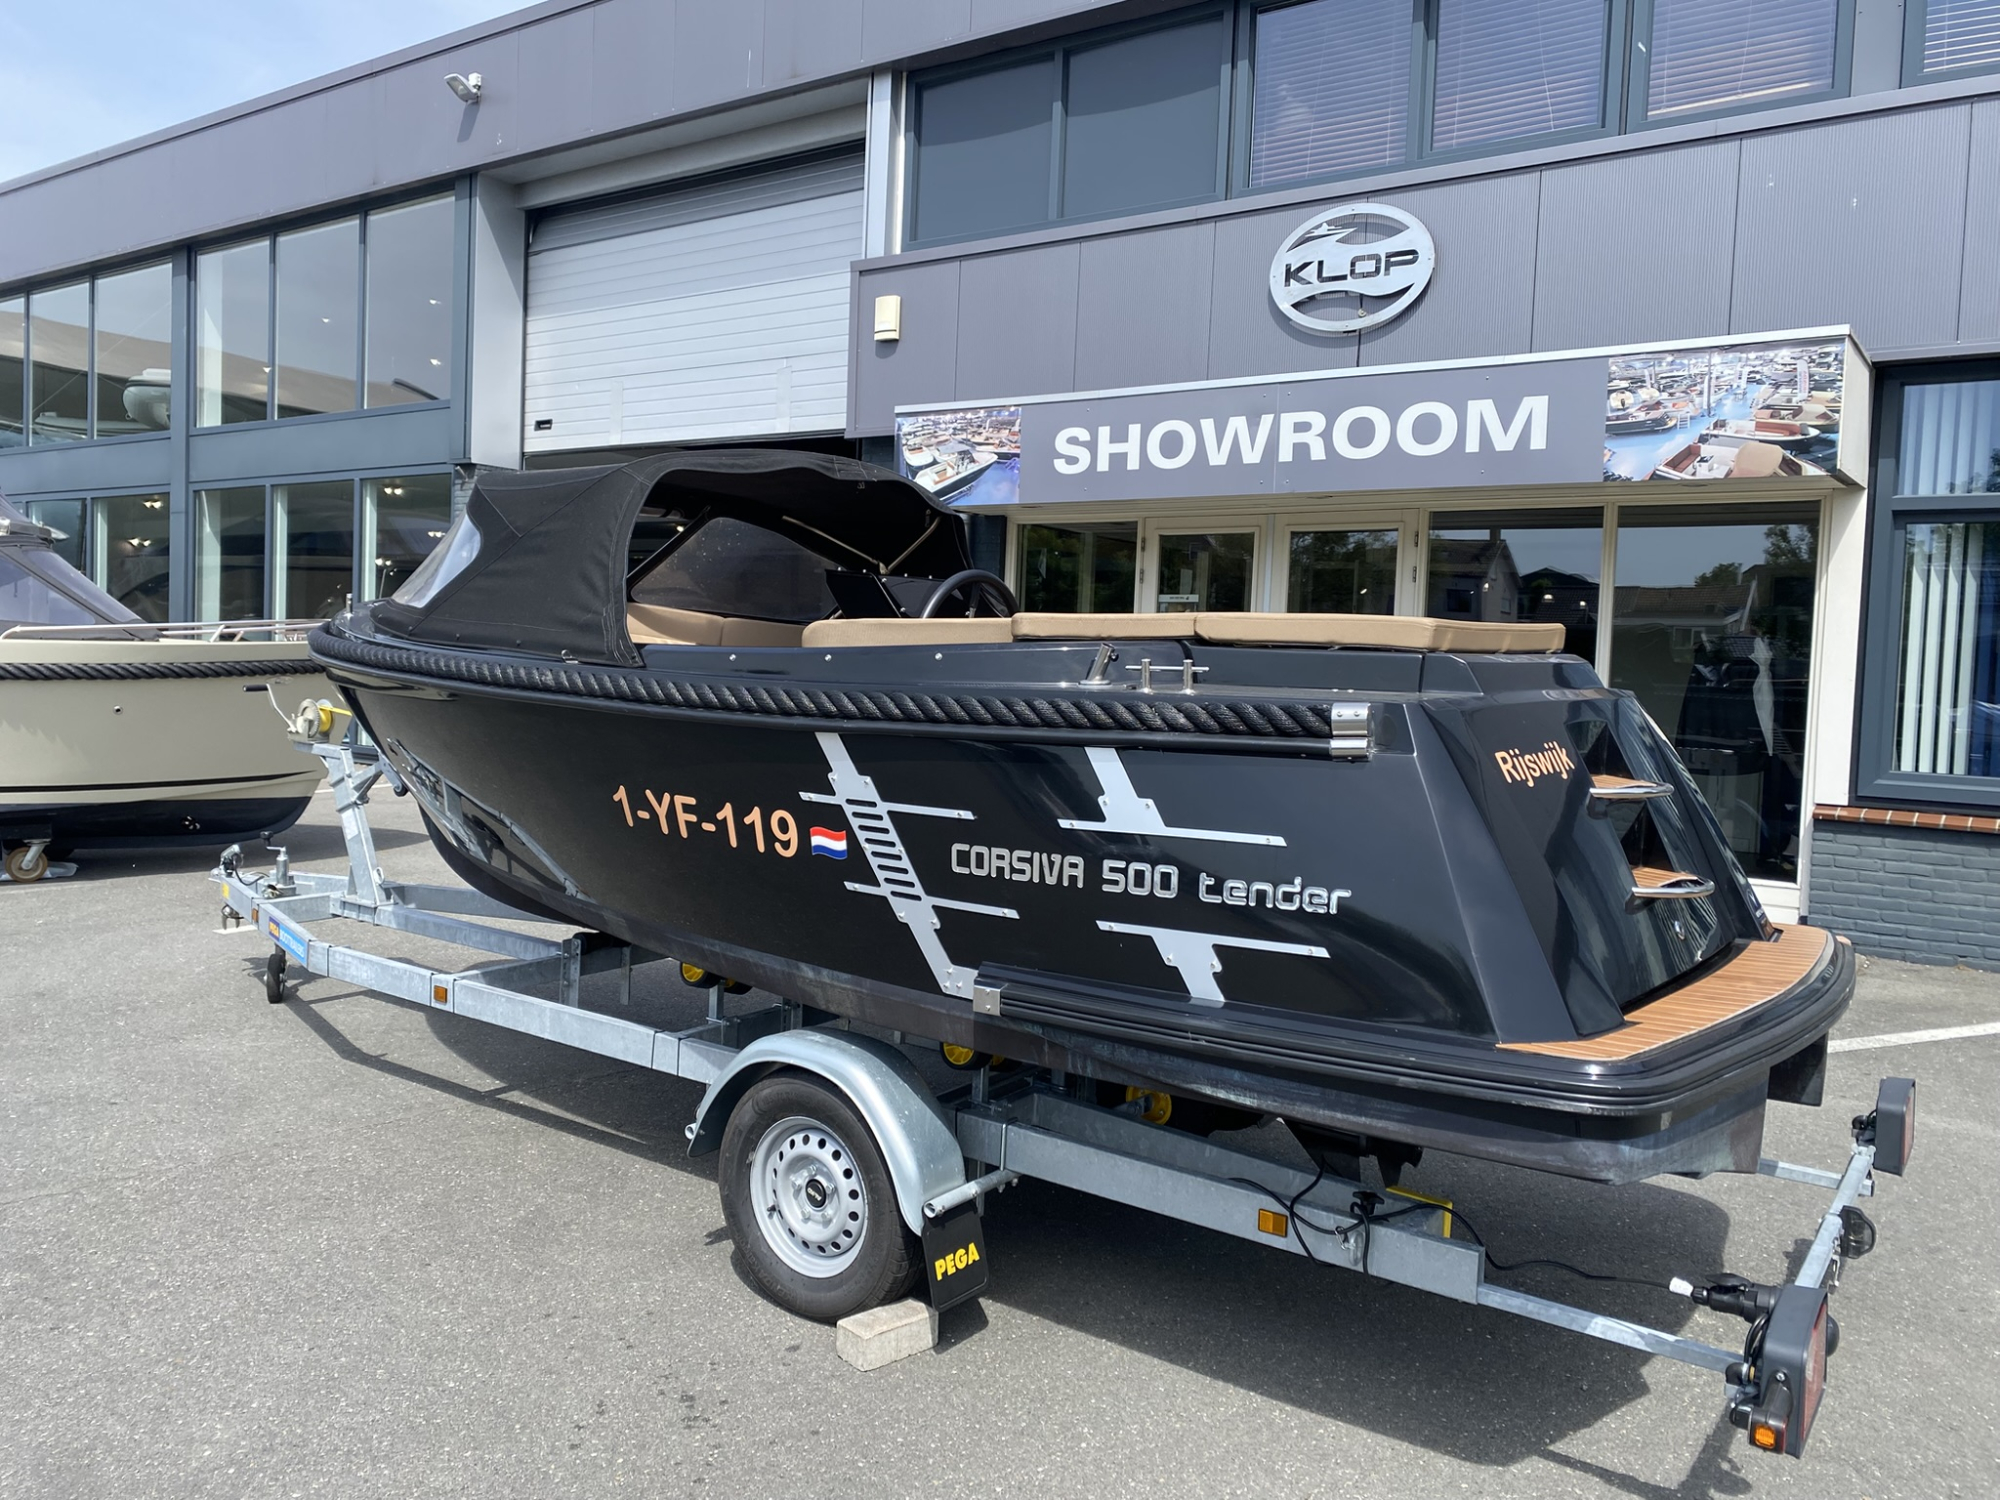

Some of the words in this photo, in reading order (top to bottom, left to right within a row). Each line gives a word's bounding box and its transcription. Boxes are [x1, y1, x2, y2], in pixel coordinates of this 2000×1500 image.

[1284, 249, 1420, 287] KLOP
[1053, 395, 1549, 475] SHOWROOM
[1494, 741, 1575, 787] Rijswijk
[612, 785, 799, 858] 1-YF-119
[951, 842, 1085, 889] CORSIVA
[1102, 859, 1179, 899] 500
[1199, 875, 1352, 915] tender
[934, 1242, 980, 1281] PEGA
